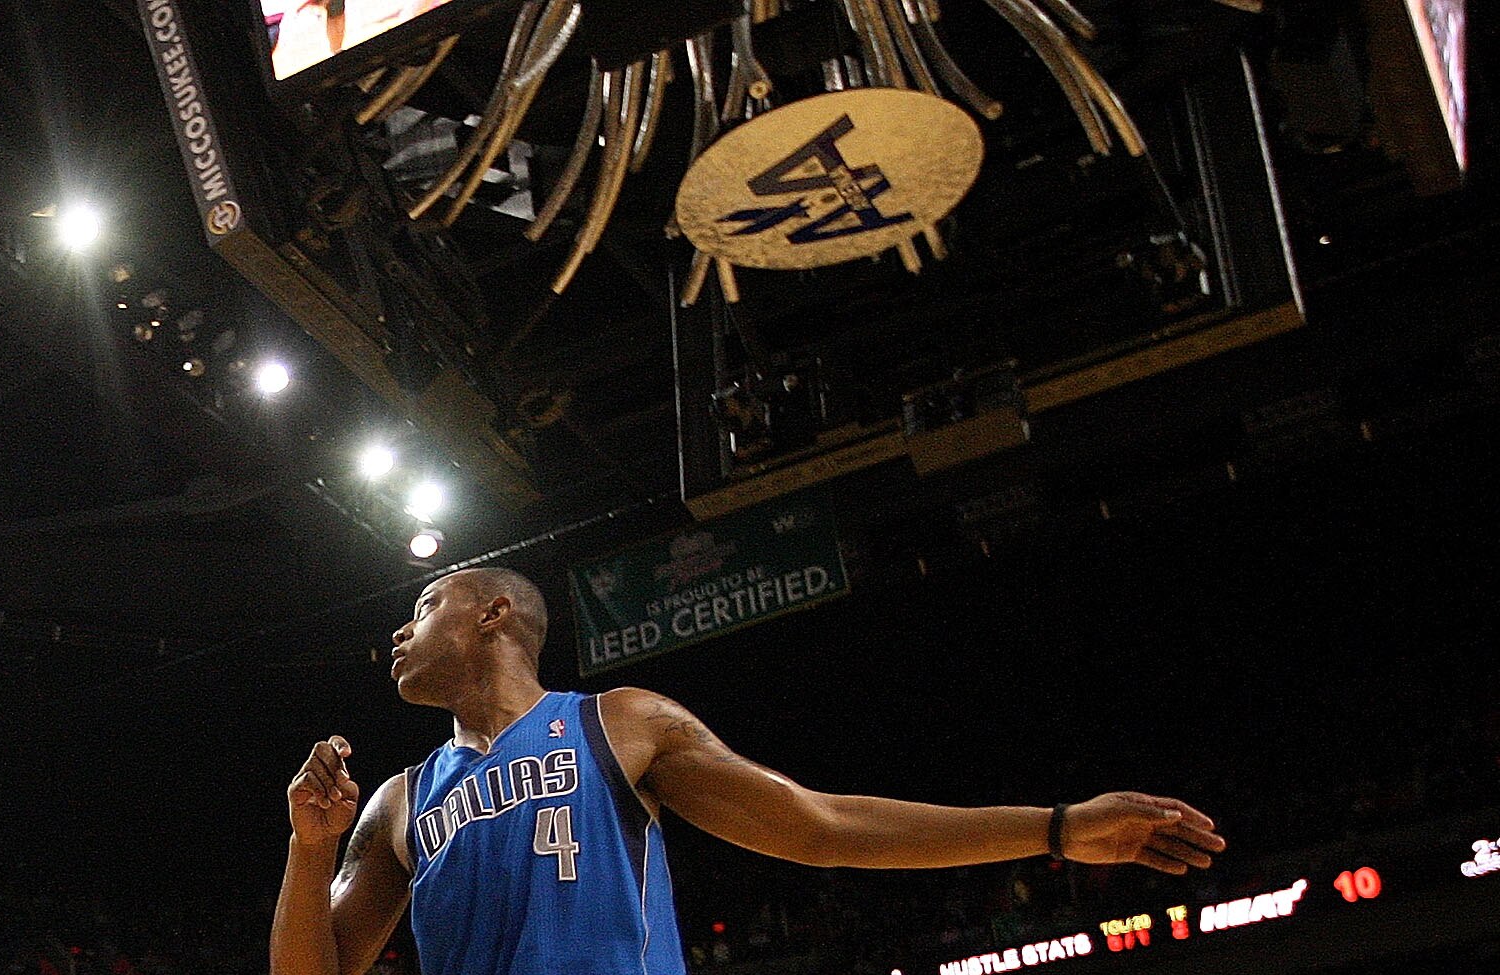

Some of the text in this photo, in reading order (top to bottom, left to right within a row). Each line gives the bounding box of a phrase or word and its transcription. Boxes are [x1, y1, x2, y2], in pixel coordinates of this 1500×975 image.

[587, 564, 837, 665] LEED CERTIFIED.
[416, 748, 579, 862] DALLAS
[533, 806, 580, 881] 4
[1200, 878, 1308, 932] HEAT
[1333, 866, 1382, 903] 10
[1021, 932, 1092, 966] STATS
